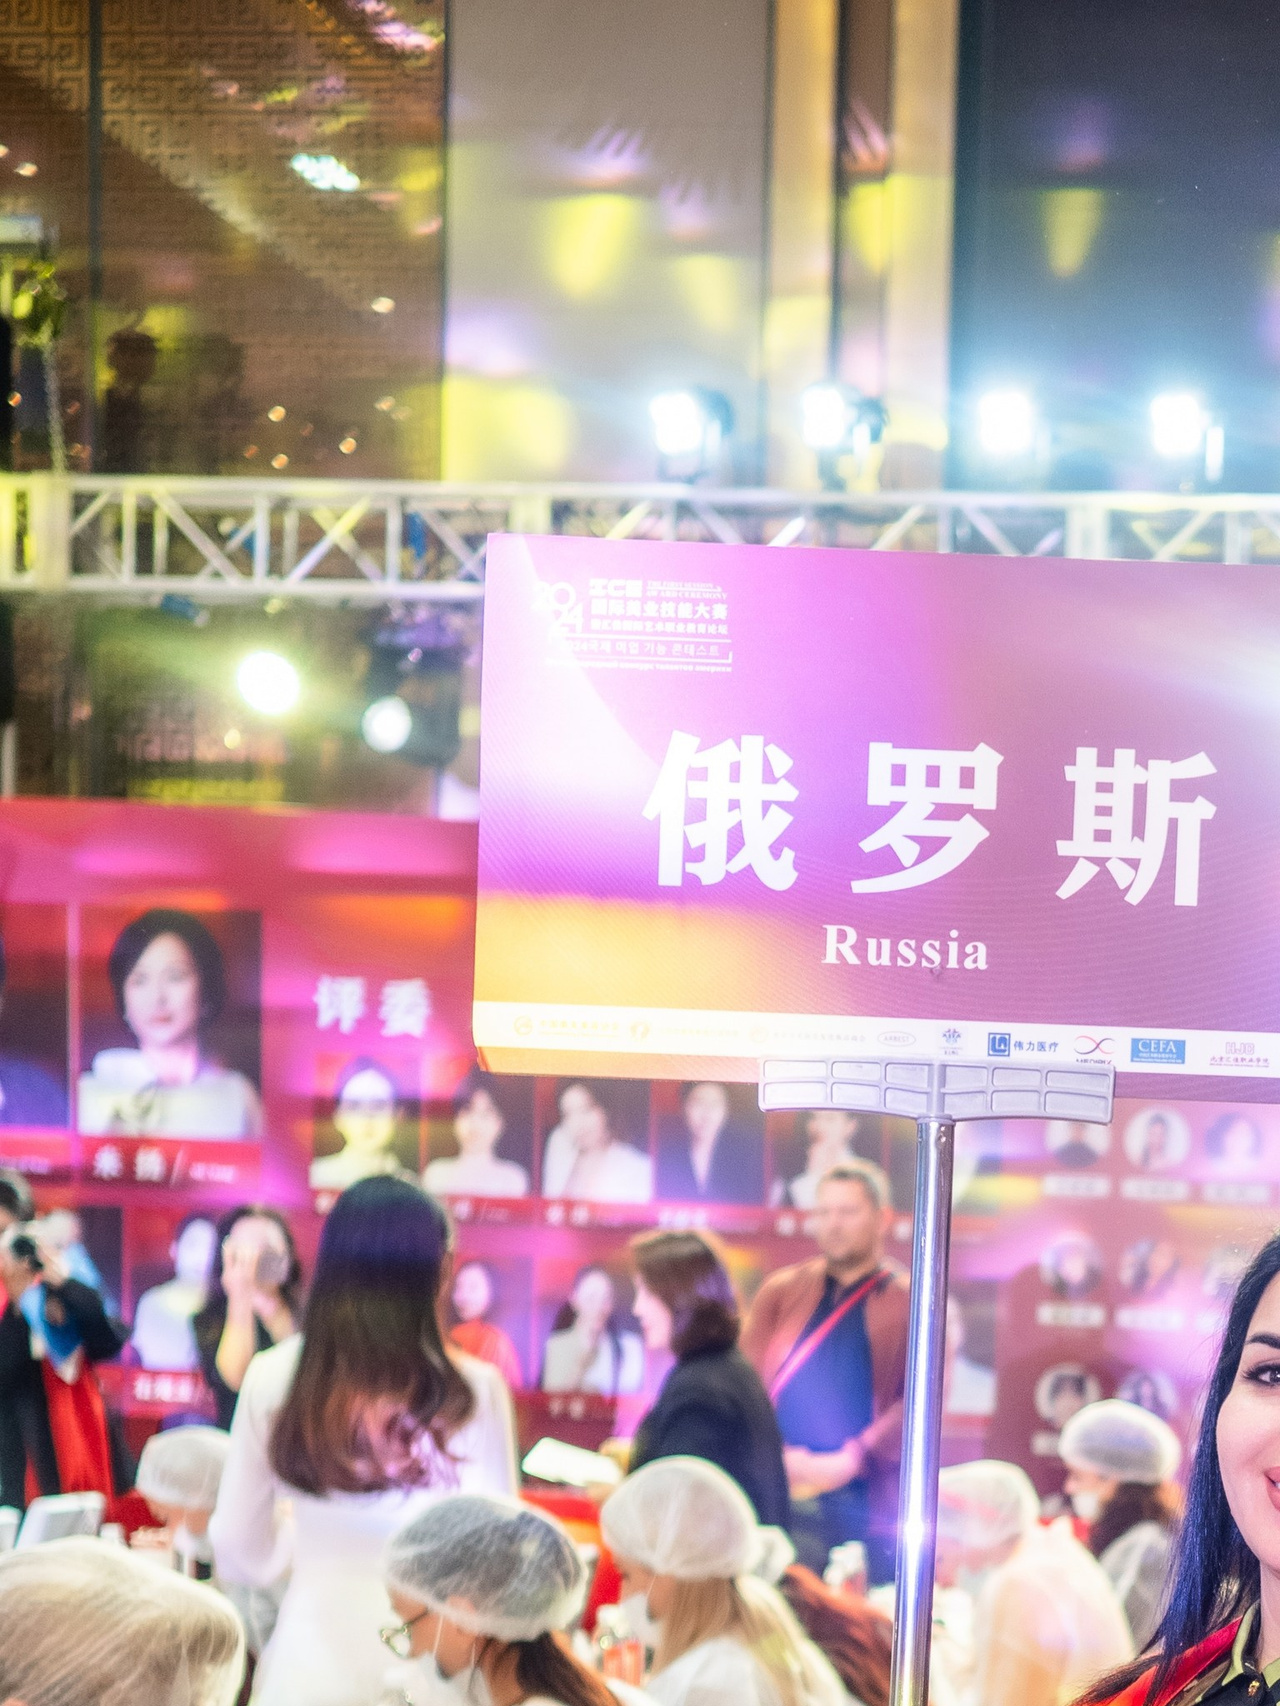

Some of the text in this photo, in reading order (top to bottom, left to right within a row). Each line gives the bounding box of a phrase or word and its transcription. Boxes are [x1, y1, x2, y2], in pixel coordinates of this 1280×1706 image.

[678, 591, 729, 600] CEREMONY
[641, 729, 1217, 908] 俄罗斯
[820, 924, 989, 971] Russia
[1013, 1040, 1059, 1053] 伟力医疗
[1138, 1039, 1177, 1053] CEFA
